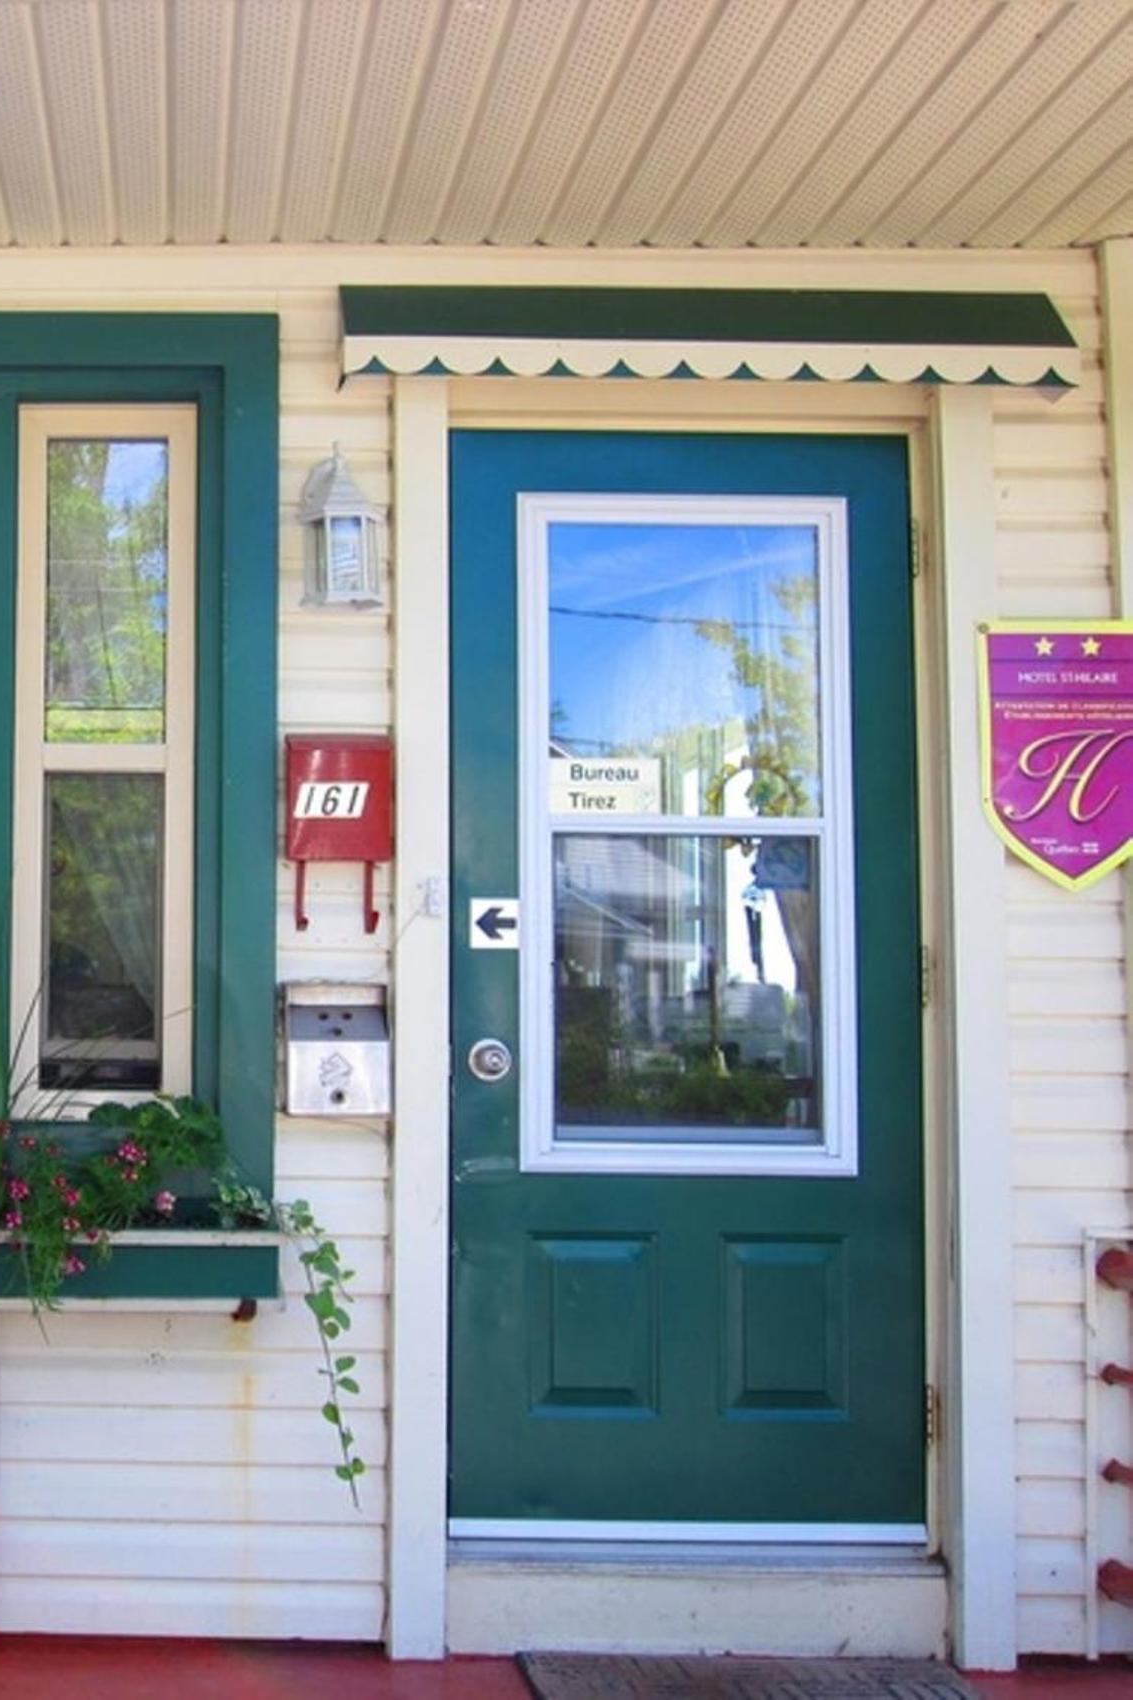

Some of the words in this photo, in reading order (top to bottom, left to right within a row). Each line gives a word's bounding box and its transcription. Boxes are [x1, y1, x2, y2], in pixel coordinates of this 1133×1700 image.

[570, 763, 639, 781] Bureau
[1003, 728, 1133, 822] H
[304, 785, 360, 815] 161
[568, 792, 617, 810] Tirez
